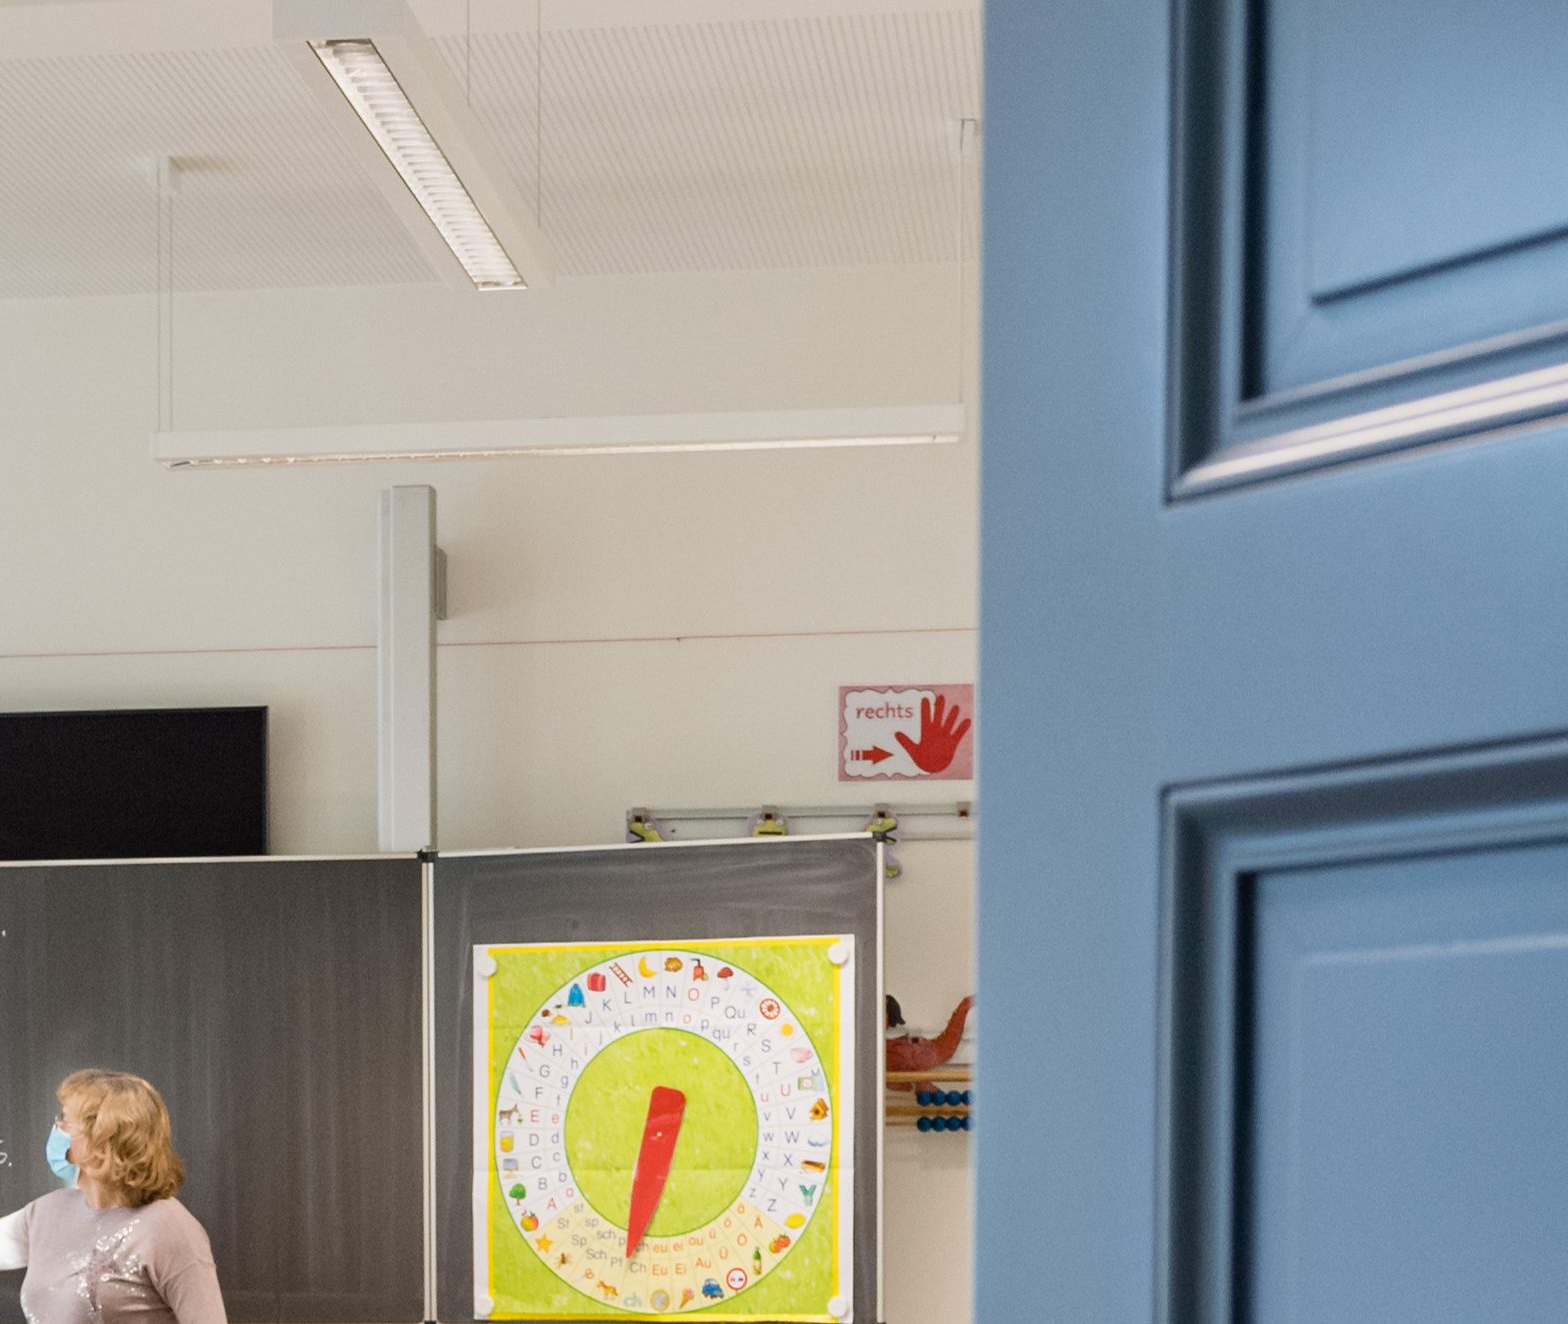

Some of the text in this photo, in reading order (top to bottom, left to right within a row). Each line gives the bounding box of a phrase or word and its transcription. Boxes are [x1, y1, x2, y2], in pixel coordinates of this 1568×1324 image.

[855, 702, 915, 720] rechts
[624, 991, 632, 1004] L
[643, 986, 656, 999] M
[666, 986, 677, 999] N
[687, 987, 700, 1002] O
[602, 999, 612, 1012] K
[711, 996, 720, 1009] P
[645, 1012, 657, 1023] m
[665, 1012, 674, 1022] n
[683, 1014, 692, 1025] o
[724, 1006, 746, 1020] Qu
[614, 1021, 621, 1032] k
[701, 1019, 709, 1032] p
[747, 1023, 757, 1036] R
[712, 1029, 731, 1042] qu
[553, 1044, 563, 1057] H
[761, 1038, 772, 1053] S
[570, 1058, 579, 1070] h
[743, 1056, 751, 1067] s
[773, 1061, 782, 1075] T
[539, 1064, 550, 1078] G
[560, 1074, 569, 1089] g
[535, 1086, 544, 1100] F
[781, 1084, 791, 1097] U
[760, 1092, 769, 1103] u
[531, 1109, 539, 1123] E
[551, 1113, 560, 1124] e
[763, 1112, 772, 1122] v
[786, 1107, 797, 1120] V
[529, 1133, 539, 1147] D
[551, 1131, 560, 1144] d
[762, 1132, 774, 1142] w
[785, 1131, 800, 1144] W
[552, 1152, 561, 1162] c
[762, 1151, 770, 1161] x
[784, 1154, 794, 1167] X
[531, 1156, 542, 1170] C
[558, 1171, 567, 1183] b
[757, 1168, 765, 1182] y
[538, 1177, 548, 1191] B
[778, 1177, 788, 1191] Y
[749, 1187, 757, 1198] z
[546, 1198, 558, 1210] A
[767, 1199, 778, 1212] Z
[571, 1234, 587, 1248] Sp
[585, 1248, 608, 1261] Sch
[629, 1261, 647, 1274] Ch
[675, 1262, 687, 1275] Ei
[695, 1257, 712, 1269] Au
[651, 1264, 668, 1276] Eu
